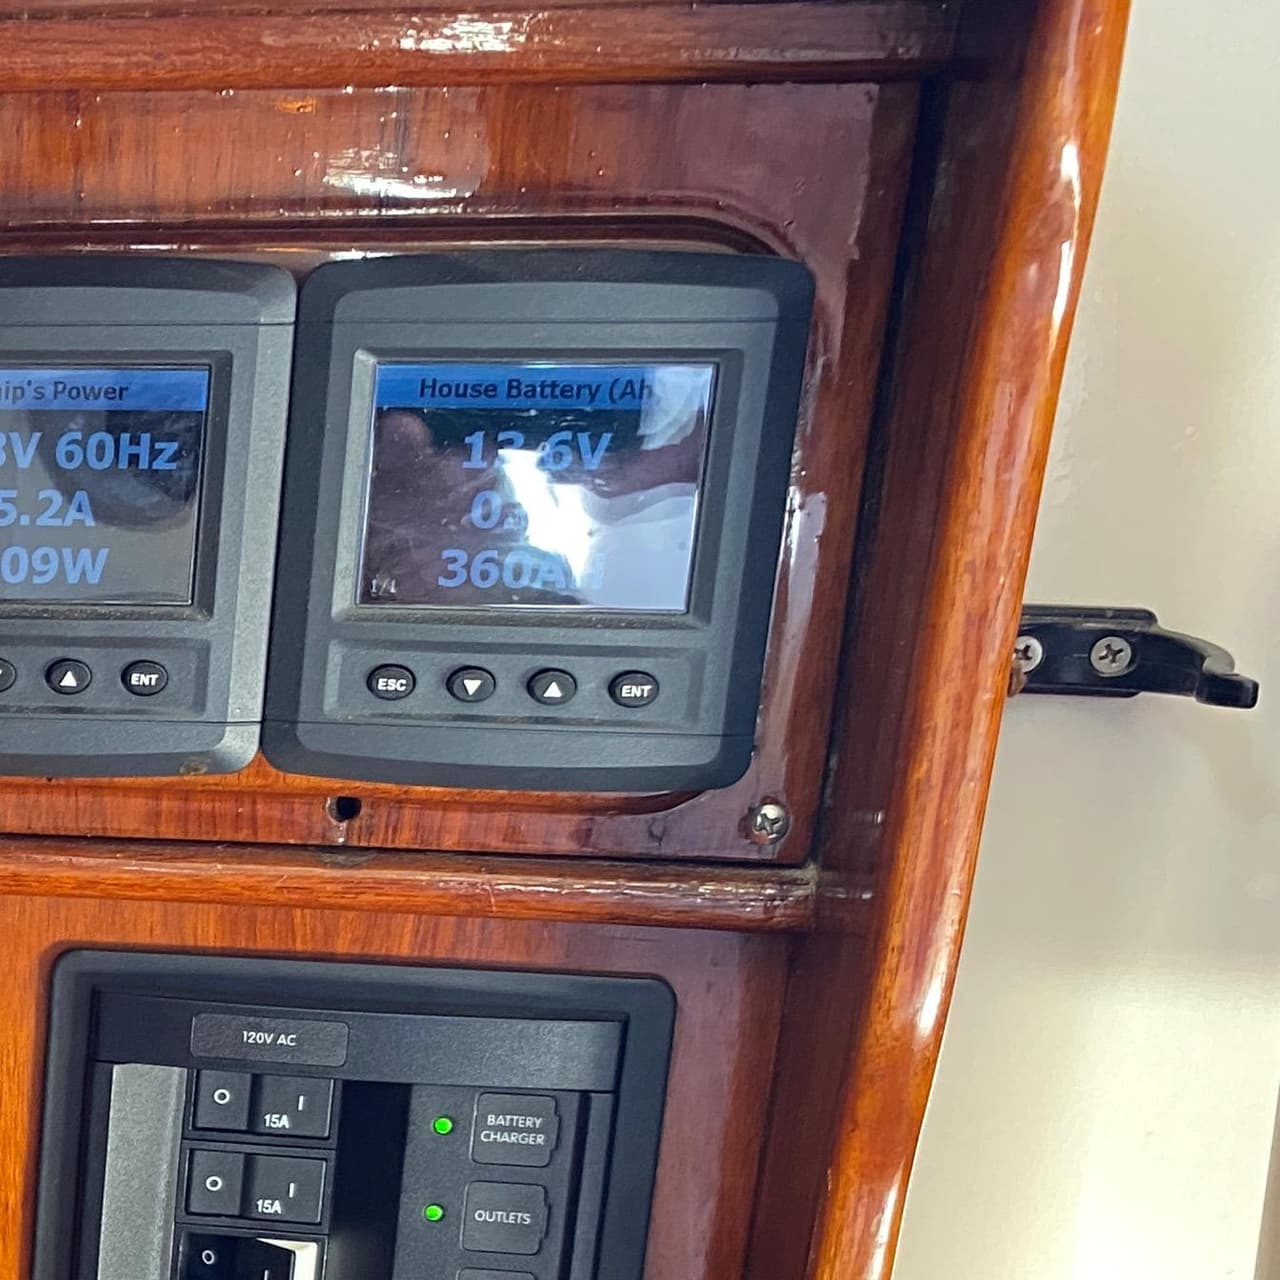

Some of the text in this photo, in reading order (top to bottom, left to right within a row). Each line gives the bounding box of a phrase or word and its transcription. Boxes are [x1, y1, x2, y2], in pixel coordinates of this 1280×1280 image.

[52, 380, 130, 401] Power
[419, 377, 665, 403] House Battery (Ah
[55, 431, 179, 471] 60Hz
[463, 431, 612, 471] 16V
[130, 672, 159, 686] ENT
[377, 678, 406, 692] ESC
[621, 684, 651, 698] ENT
[242, 1030, 297, 1046] 120V AC
[264, 1113, 289, 1129] 15A
[487, 1114, 543, 1129] BATTERY
[480, 1130, 545, 1145] CHARGER
[256, 1199, 282, 1214] 15A
[474, 1210, 531, 1225] OUTLETS
